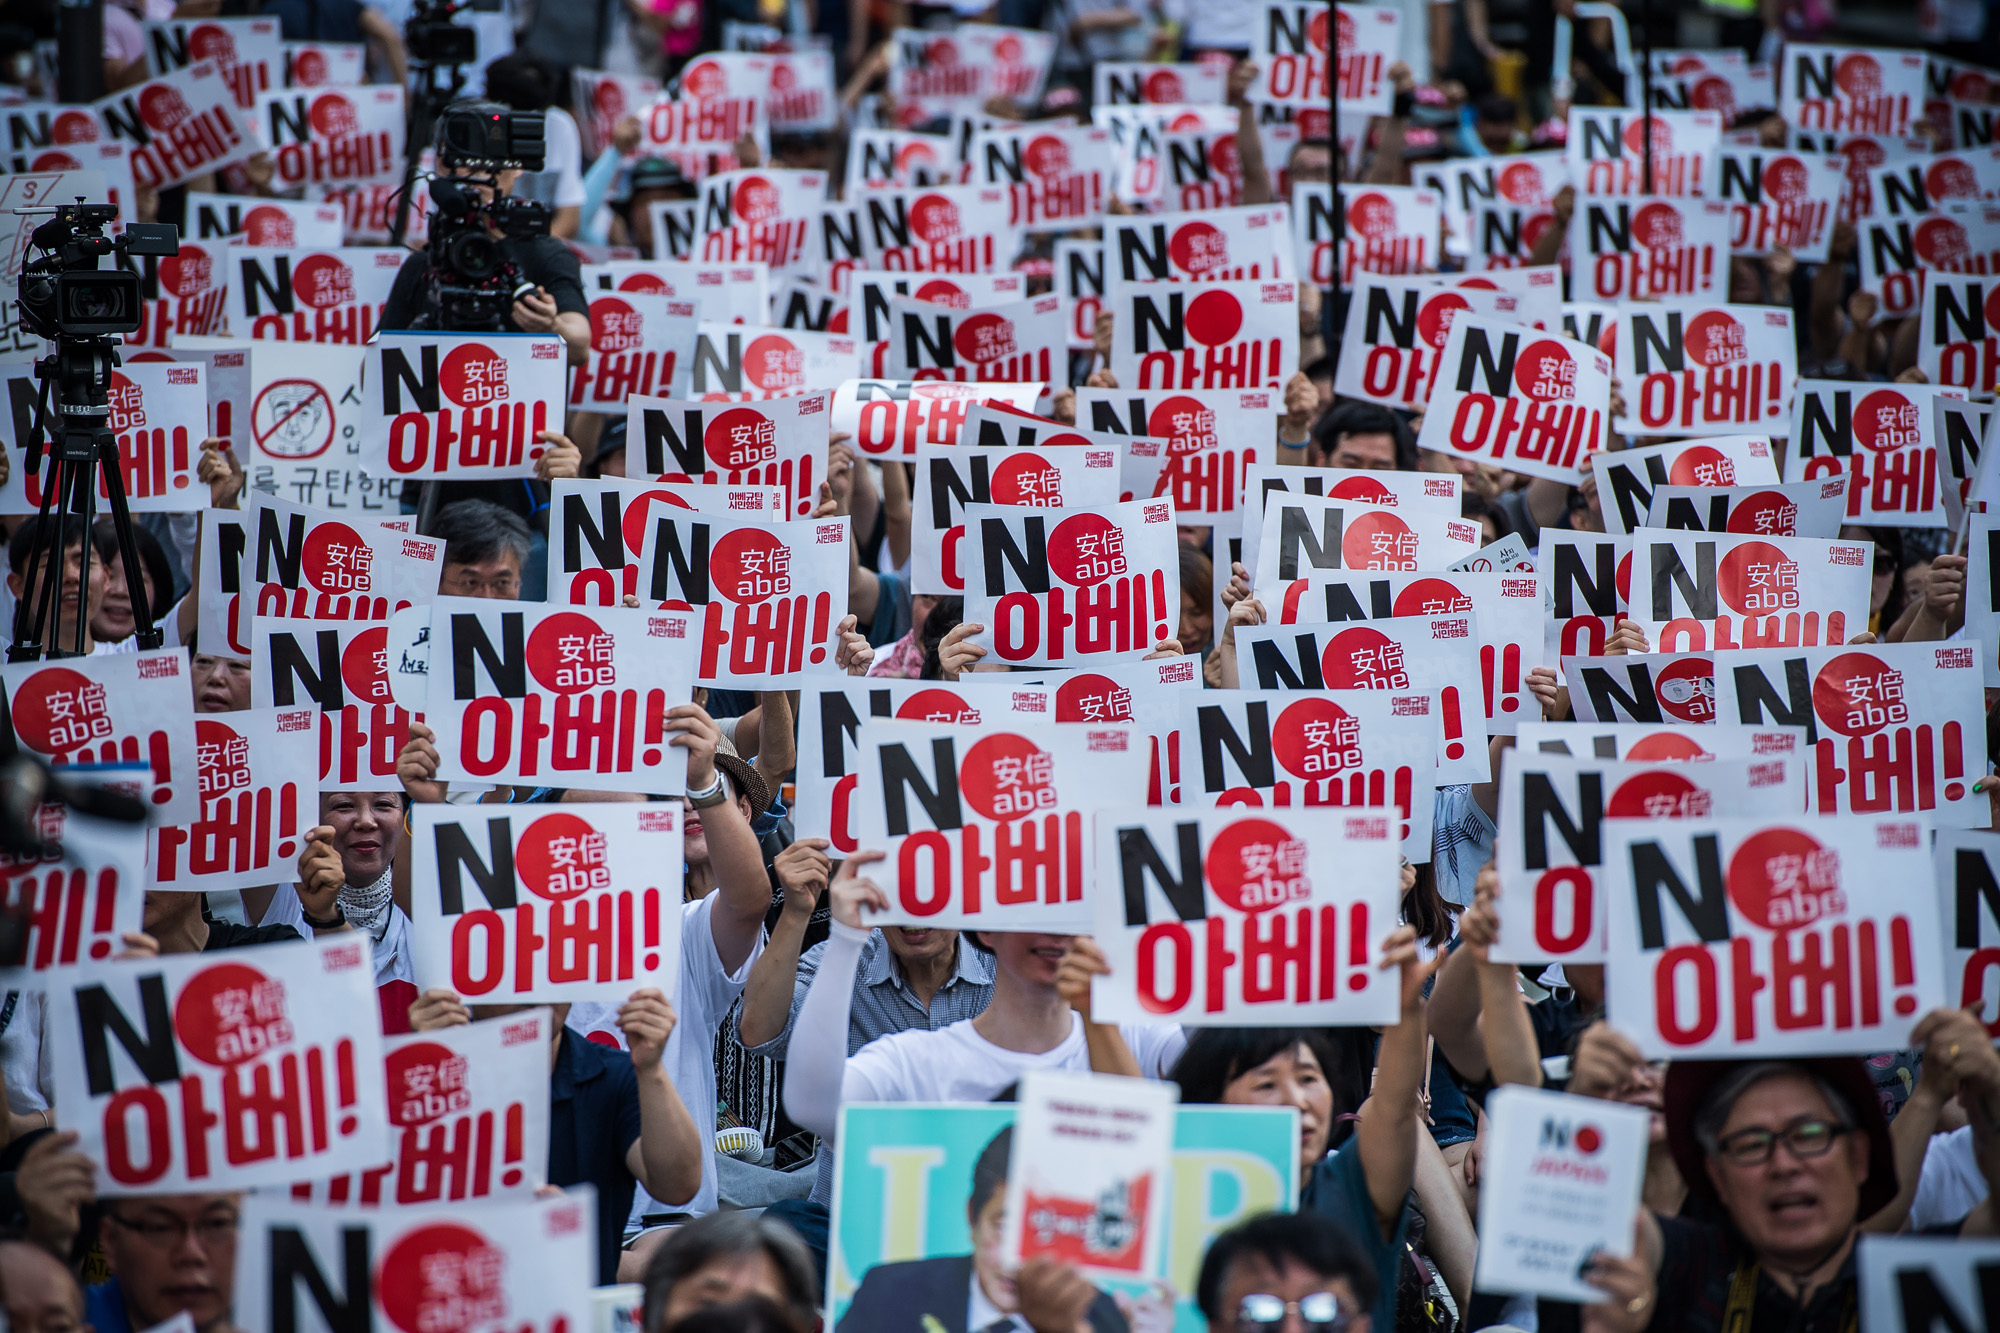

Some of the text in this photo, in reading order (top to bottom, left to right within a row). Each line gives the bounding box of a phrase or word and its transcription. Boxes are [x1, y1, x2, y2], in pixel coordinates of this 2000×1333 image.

[130, 103, 242, 188] 아베!
[278, 131, 391, 182] 아베!
[1594, 245, 1713, 299] 아베!
[1705, 345, 1748, 364] abe
[464, 358, 508, 384] 安倍
[462, 381, 509, 403] abe
[1532, 380, 1576, 400] abe
[1640, 362, 1781, 428] 아베!
[731, 419, 776, 447] 安倍
[1172, 432, 1218, 452] abe
[1875, 428, 1920, 448] abe
[729, 442, 777, 466] abe
[1017, 468, 1062, 495] 安倍
[1424, 479, 1454, 490] 아베규탄
[728, 491, 763, 502] 아베규탄
[728, 499, 763, 510] 시민행동
[1143, 503, 1169, 515] 아베규탄
[816, 522, 844, 535] 아베규탄
[1144, 512, 1170, 524] 시민행동
[1447, 521, 1476, 533] 아베규탄
[1754, 503, 1797, 532] 安倍
[402, 538, 437, 552] 아베규탄
[815, 533, 843, 545] 시민행동
[1076, 527, 1124, 558] 安倍
[1371, 530, 1419, 557] 安倍
[1446, 530, 1475, 544] 시민행동
[327, 542, 373, 572] 安倍
[401, 548, 435, 561] 시민행동
[740, 545, 791, 575] 安倍
[1828, 546, 1865, 557] 아베규탄
[1828, 555, 1864, 566] 시민행동
[1076, 554, 1127, 579] abe
[1747, 560, 1799, 588] 安倍
[321, 568, 372, 592] abe
[737, 574, 791, 597] abe
[1501, 579, 1537, 589] 아베규탄
[1501, 587, 1536, 598] 시민행동
[1744, 587, 1800, 610] abe
[648, 617, 687, 628] 아베규탄
[993, 569, 1168, 661] 아베!
[1431, 619, 1469, 631] 아베규탄
[1431, 627, 1469, 639] 시민행동
[558, 634, 615, 664] 安倍
[1351, 640, 1404, 677] 安倍
[1935, 647, 1974, 660] 아베규탄
[556, 662, 616, 687] abe
[1158, 662, 1194, 674] 아베규탄
[1935, 657, 1974, 669] 시민행동
[1159, 671, 1194, 684] 시민행동
[1845, 669, 1904, 706] 安倍
[45, 683, 107, 722] 安倍
[1079, 687, 1132, 723] 安倍
[1846, 700, 1908, 730] abe
[276, 711, 312, 723] 아베규탄
[49, 715, 113, 747] abe
[460, 688, 665, 776] 아베!
[1304, 715, 1361, 749] 安倍
[198, 737, 249, 769] 安倍
[1304, 747, 1363, 773] abe
[198, 766, 251, 793] abe
[993, 786, 1057, 814] abe
[549, 832, 607, 868] 安倍
[547, 866, 611, 894] abe
[452, 888, 660, 996] 아베!
[1137, 902, 1369, 1015] 아베!
[1655, 915, 1917, 1046] 아베!
[105, 1038, 358, 1186] 아베!
[1541, 1117, 1602, 1155] NO
